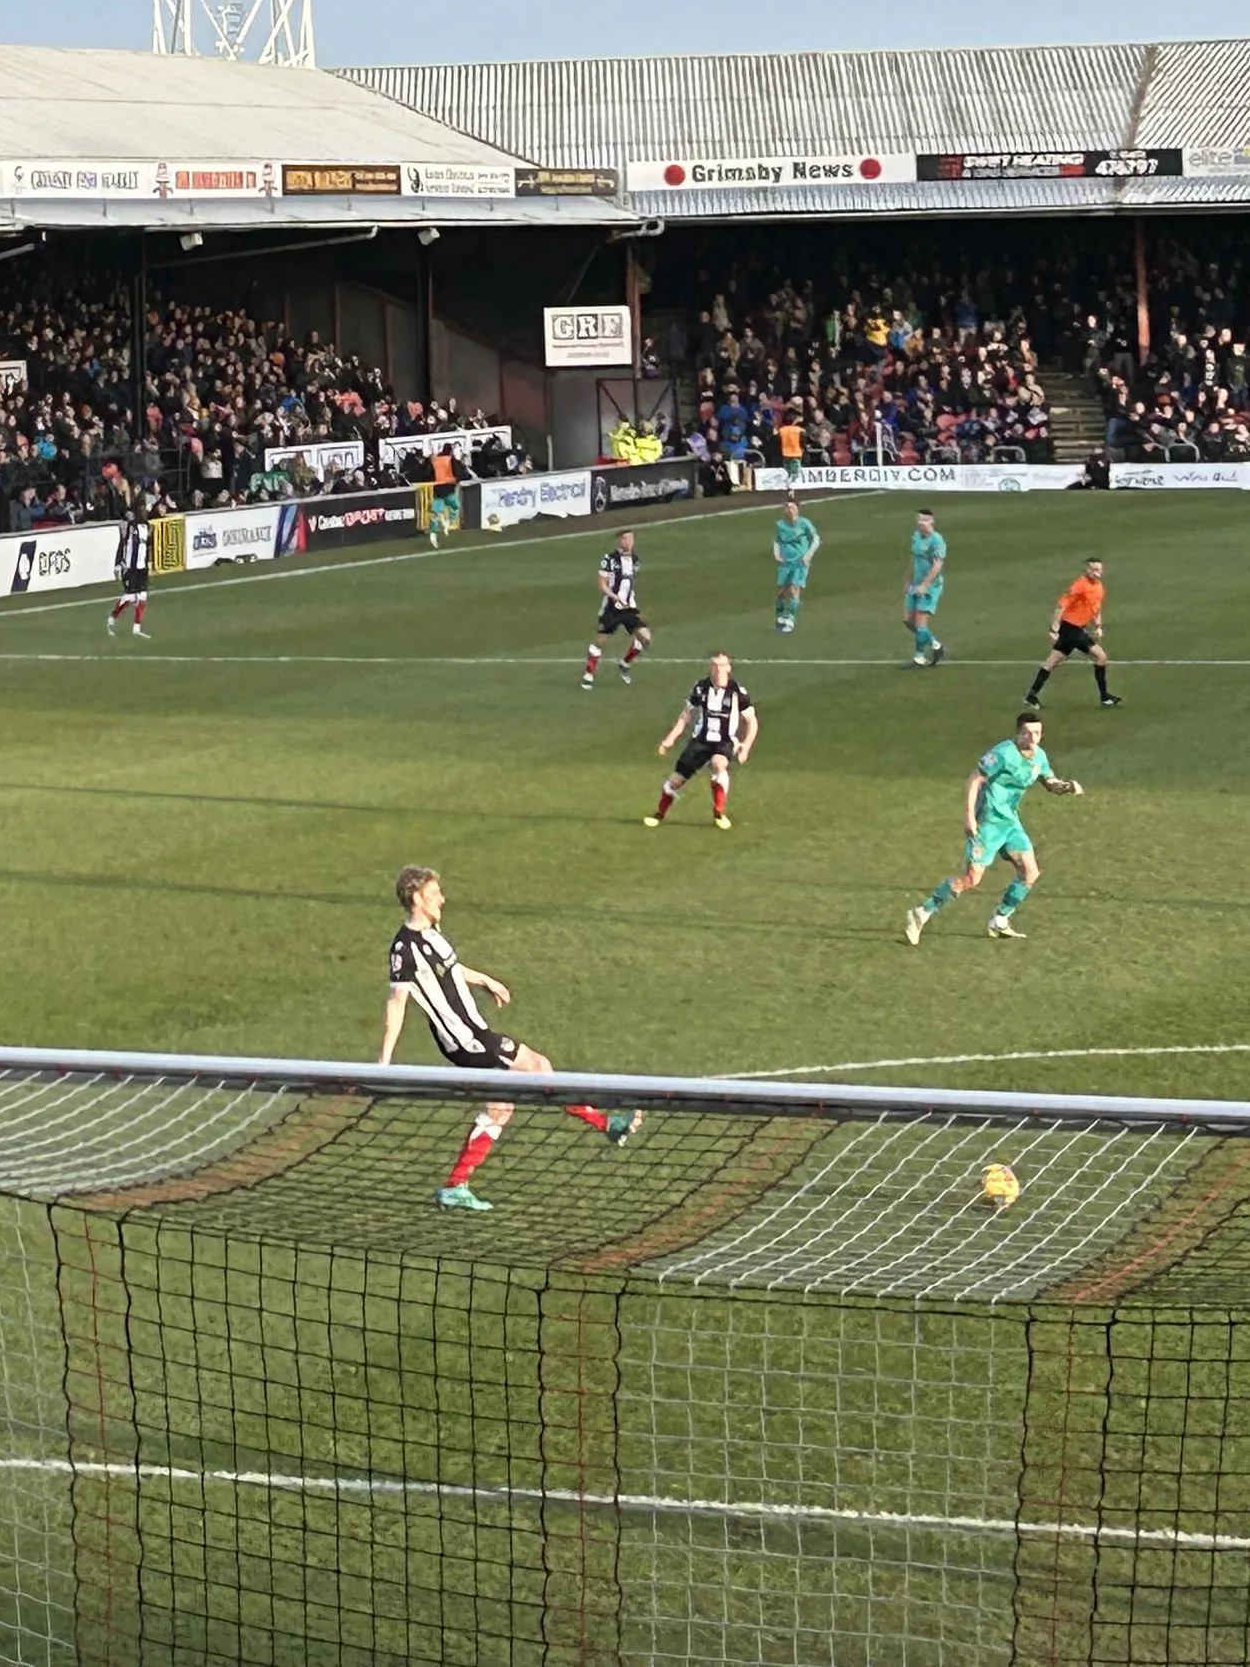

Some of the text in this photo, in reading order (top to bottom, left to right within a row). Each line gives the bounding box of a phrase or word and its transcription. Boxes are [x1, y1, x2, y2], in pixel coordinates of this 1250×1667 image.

[692, 161, 854, 183] Grimsby News
[800, 468, 956, 483] IMBERDIY.COM
